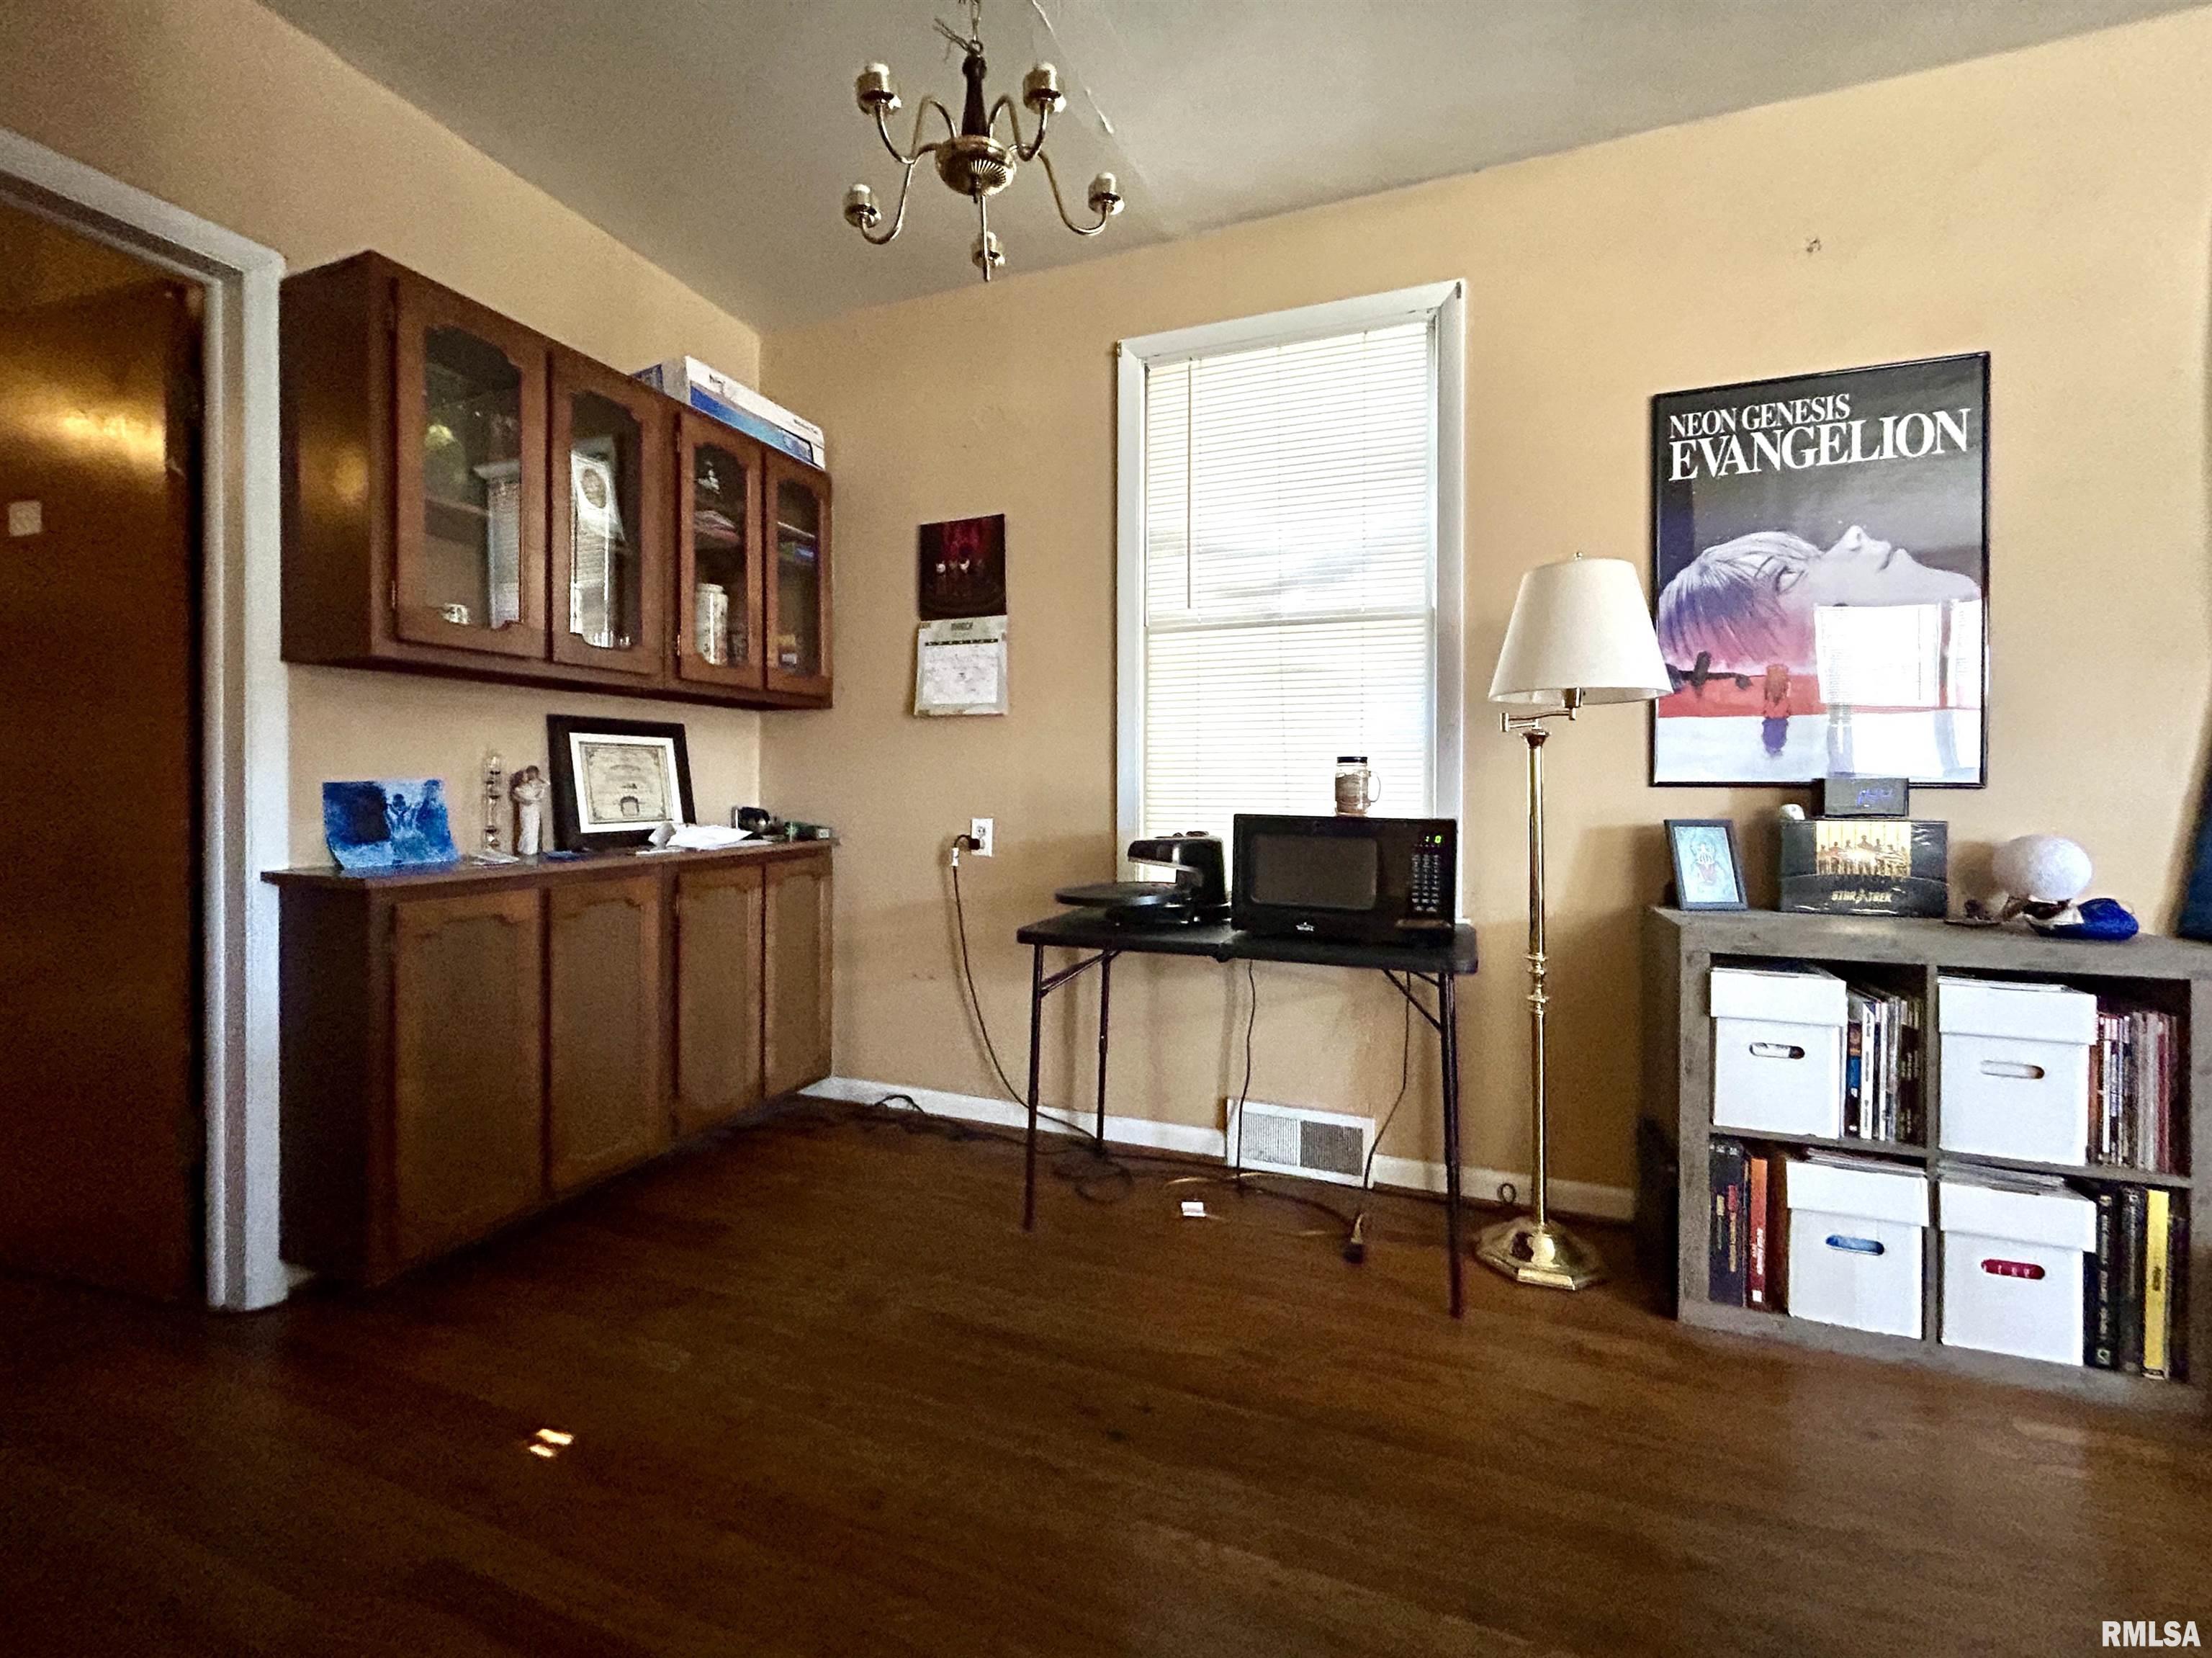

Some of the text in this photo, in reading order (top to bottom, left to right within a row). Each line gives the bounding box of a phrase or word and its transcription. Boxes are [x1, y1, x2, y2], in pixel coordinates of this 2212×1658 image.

[1669, 393, 1851, 439] NEON GENESIS
[1668, 408, 1972, 482] EVANGELION
[1831, 890, 1892, 903] STAR TREK
